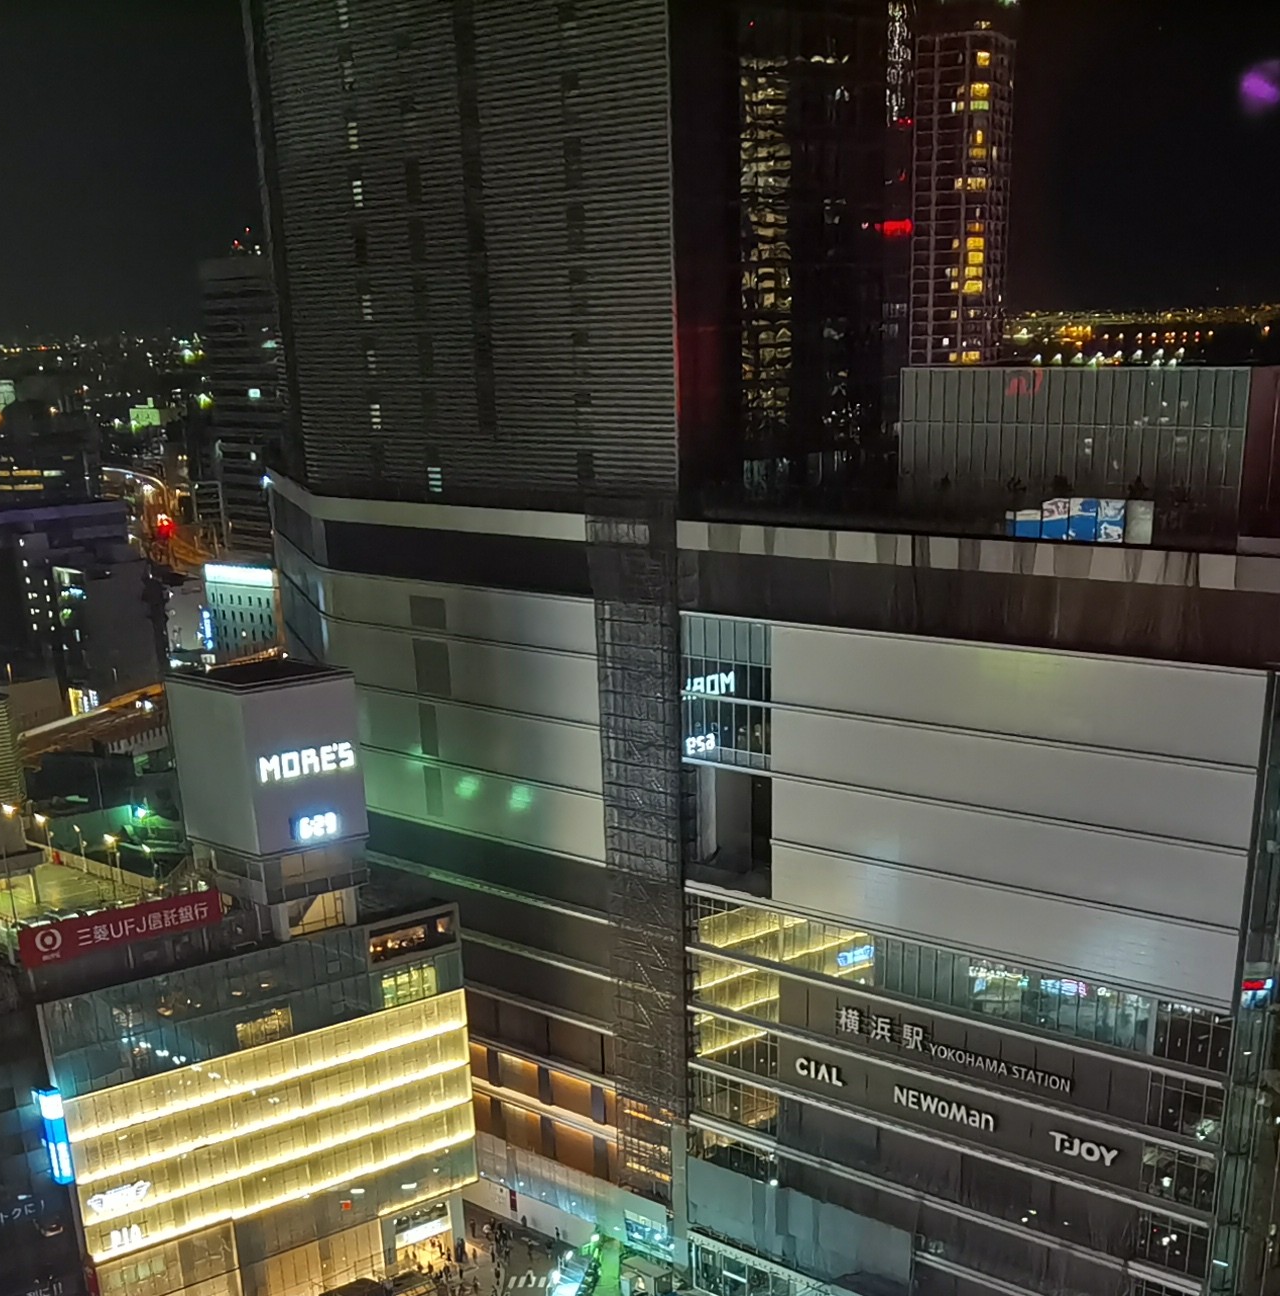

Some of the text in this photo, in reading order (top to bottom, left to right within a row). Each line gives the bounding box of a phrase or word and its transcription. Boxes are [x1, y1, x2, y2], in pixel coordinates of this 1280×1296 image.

[259, 742, 354, 782] MORE'S
[77, 902, 209, 946] 三菱UFJ信託銀行
[839, 1006, 923, 1052] 横浜駅
[796, 1058, 844, 1087] CIAL
[929, 1043, 1071, 1093] YOKOHAMA STATION
[894, 1085, 995, 1132] NEWoMan
